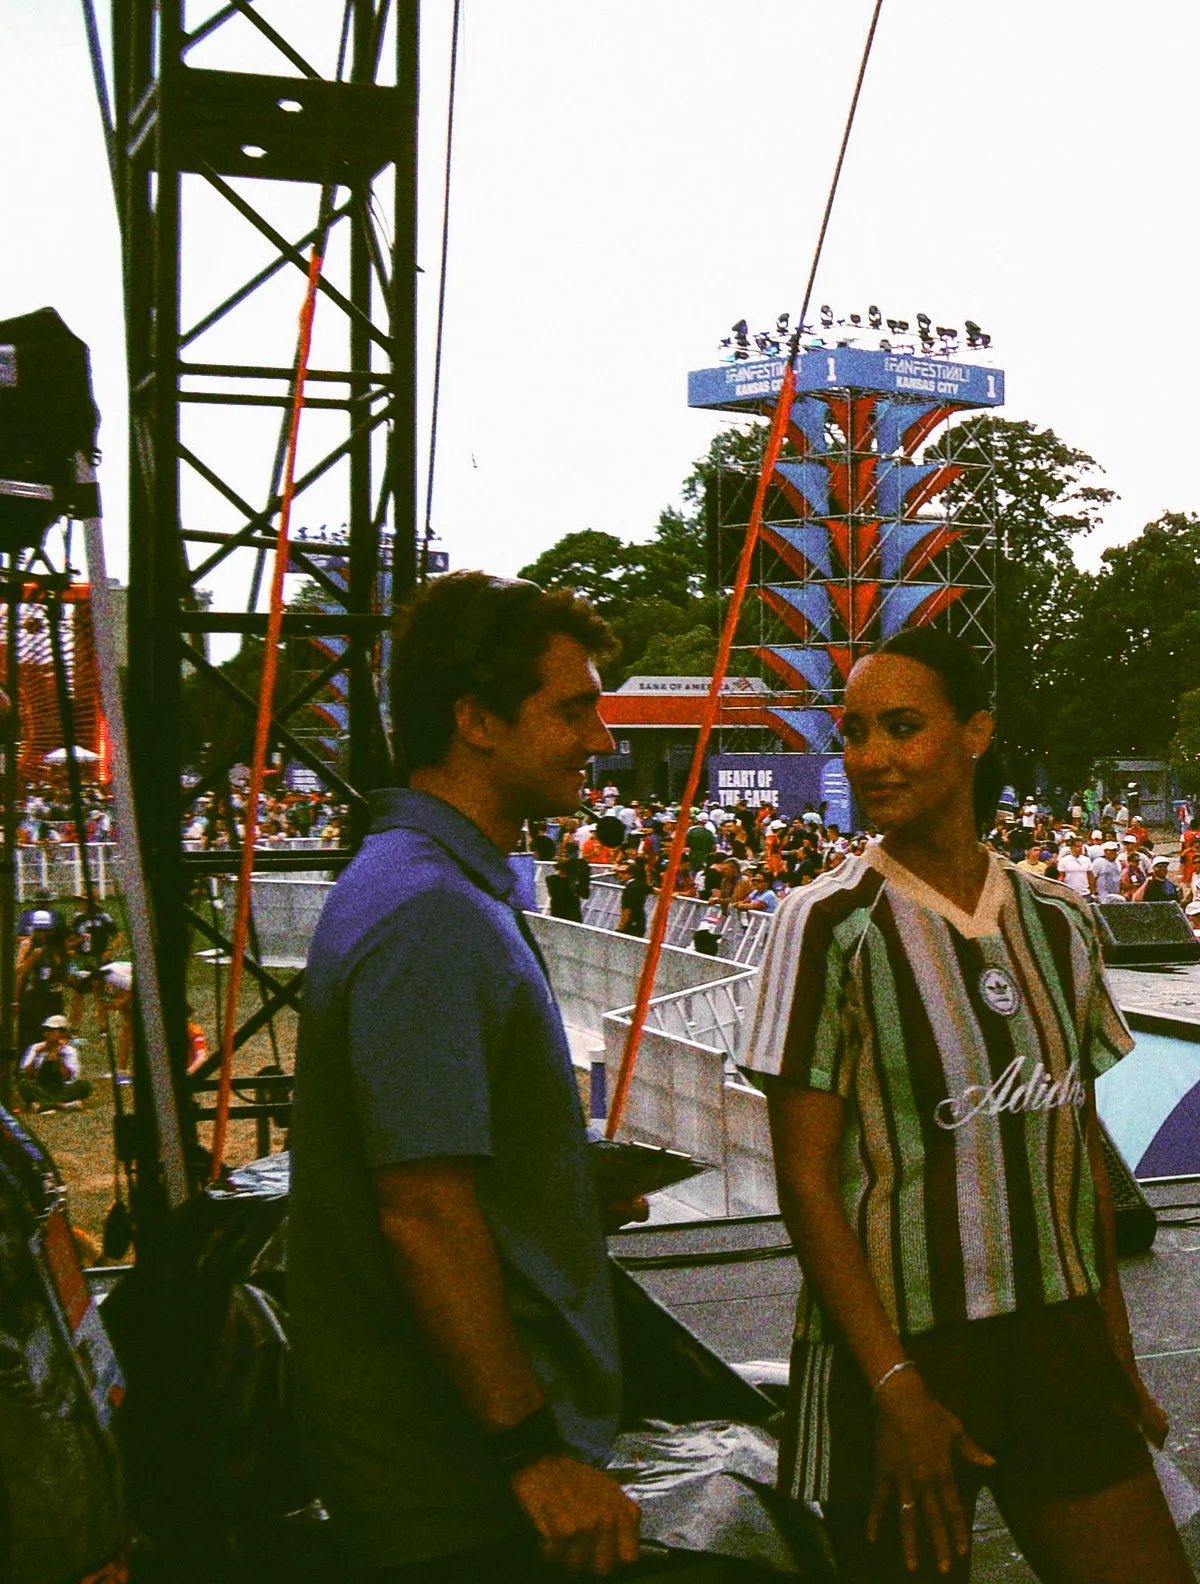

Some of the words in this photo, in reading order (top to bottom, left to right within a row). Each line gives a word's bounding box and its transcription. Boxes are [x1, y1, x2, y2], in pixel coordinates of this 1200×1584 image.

[827, 357, 837, 382] 1
[896, 376, 936, 392] KANSAS
[937, 381, 959, 395] CITY
[987, 375, 996, 398] 1
[639, 683, 667, 691] BANK
[669, 683, 682, 691] OF
[718, 770, 756, 788] HEART
[757, 770, 773, 788] OF
[718, 790, 740, 807] THE
[744, 790, 779, 808] SAME
